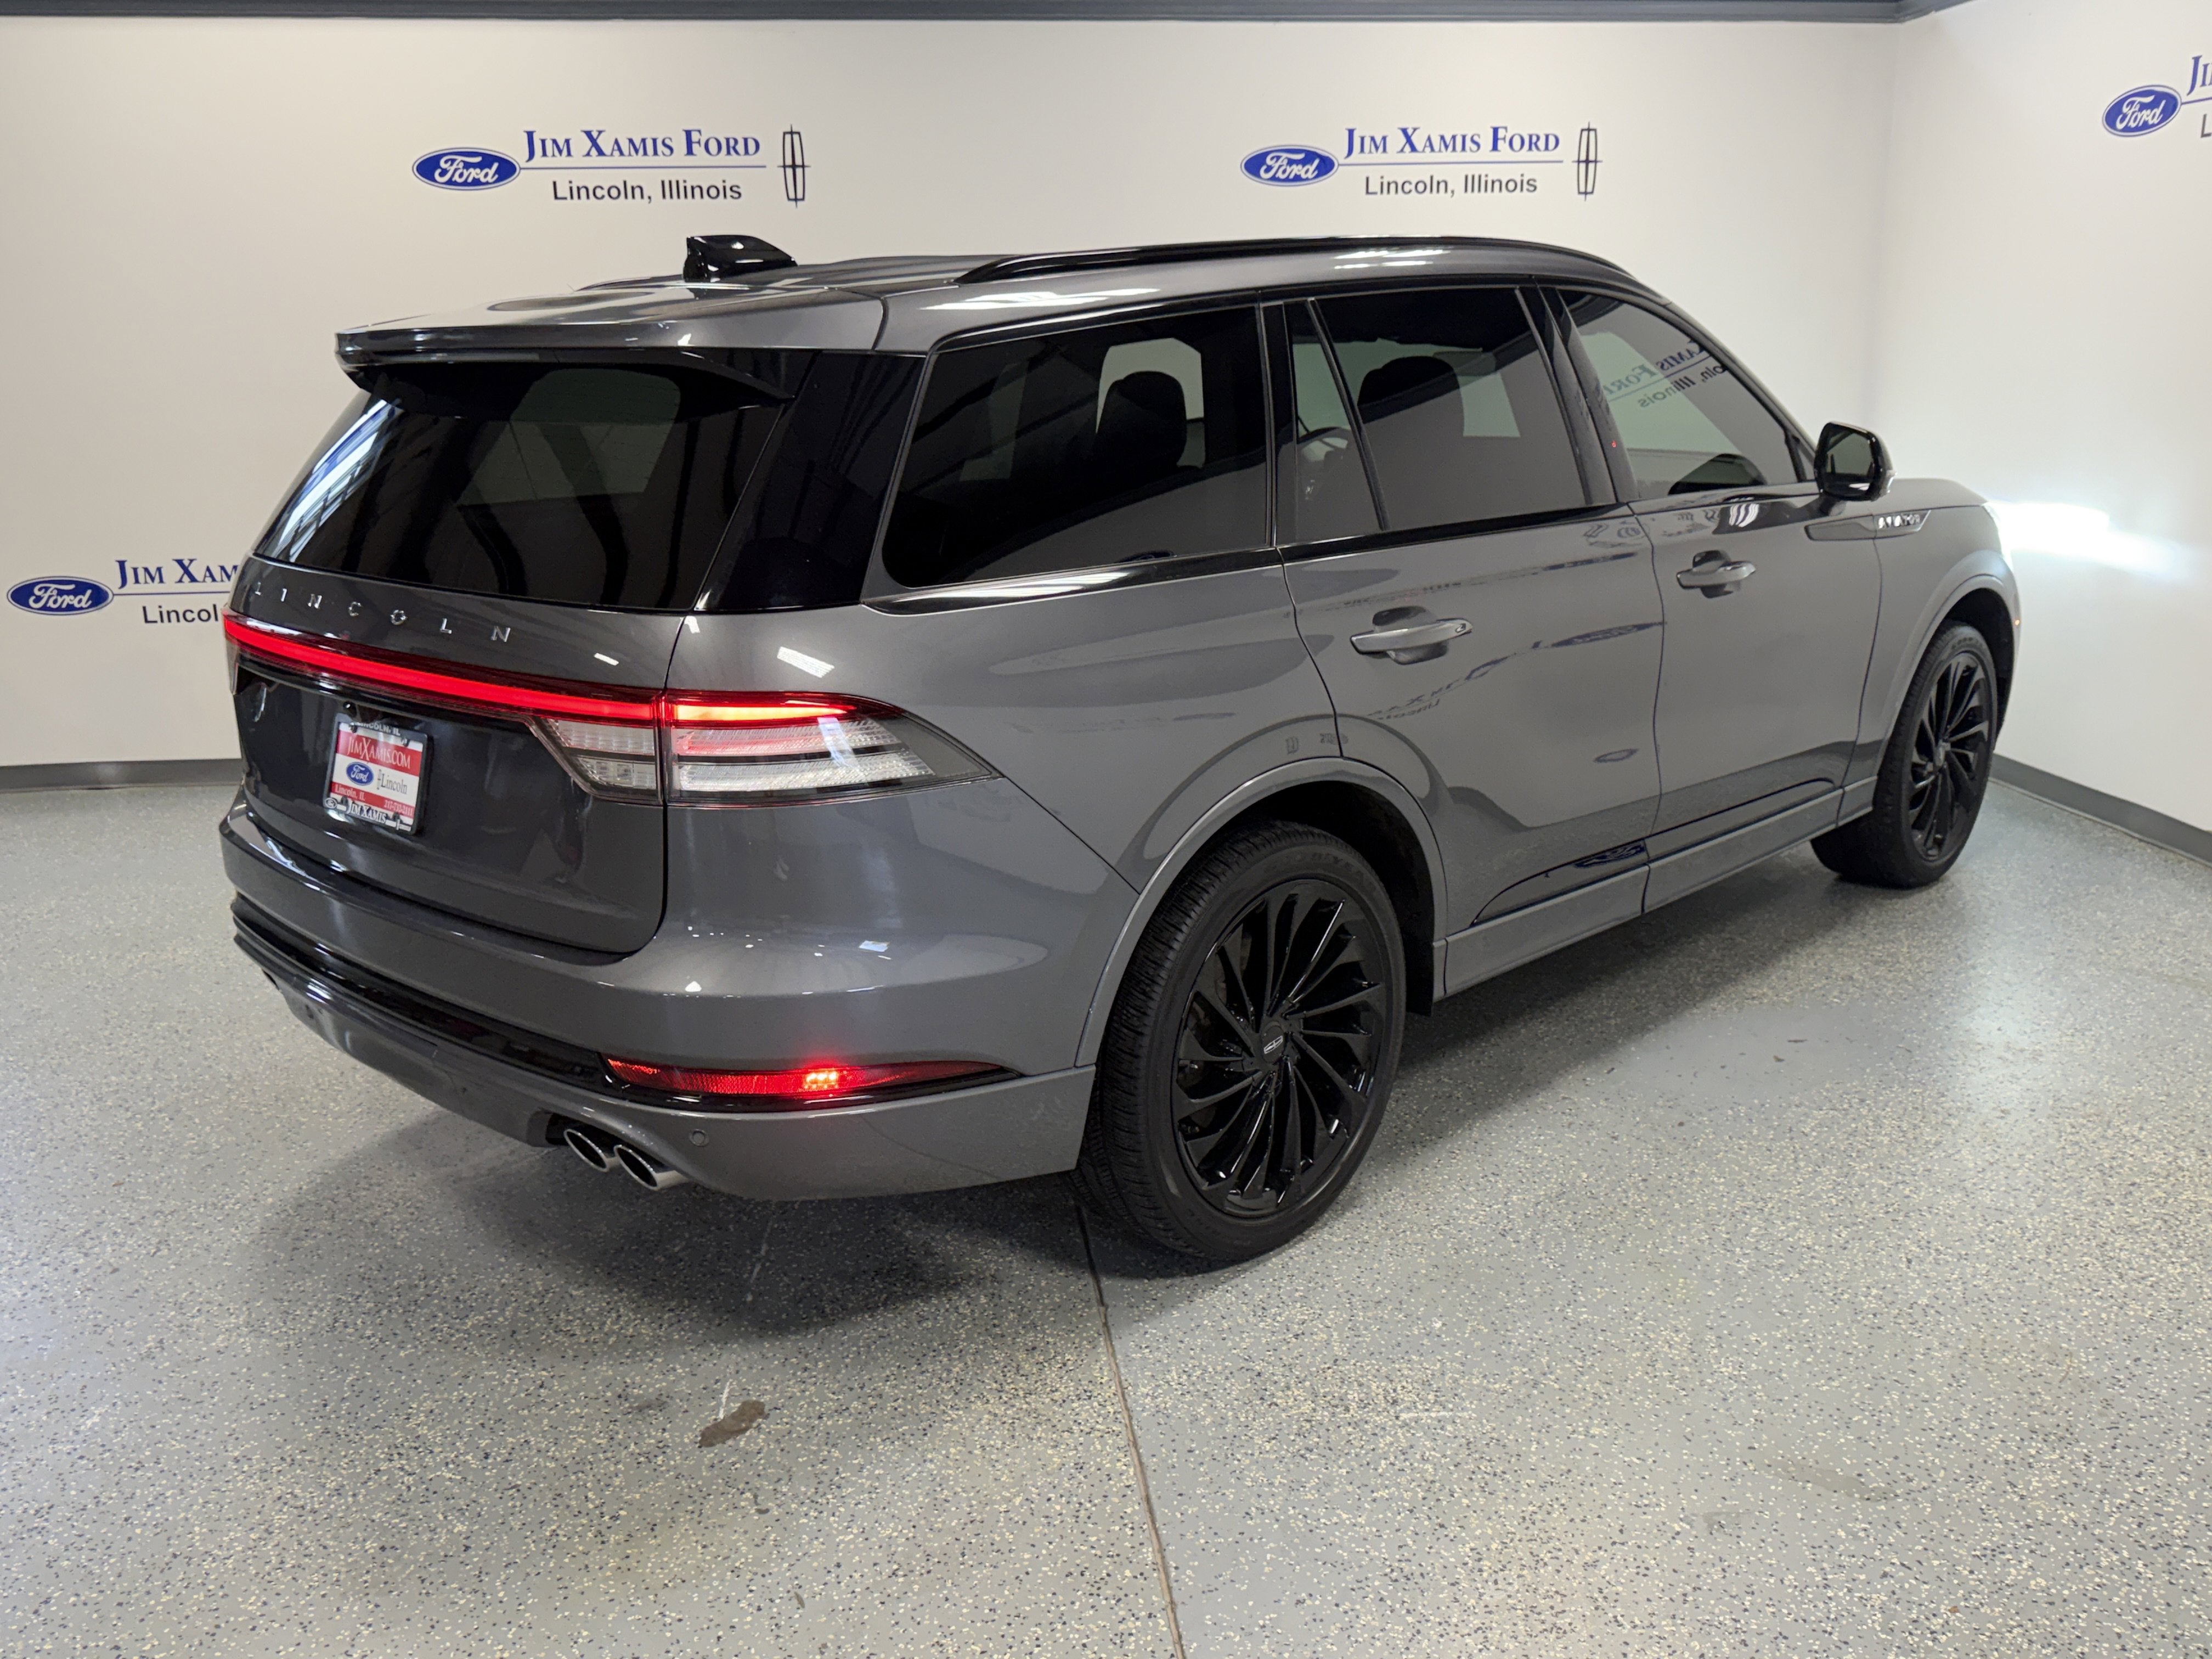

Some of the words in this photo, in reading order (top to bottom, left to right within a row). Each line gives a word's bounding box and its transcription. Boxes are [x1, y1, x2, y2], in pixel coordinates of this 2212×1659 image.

[2187, 55, 2212, 96] JI
[2116, 94, 2166, 130] Ford
[523, 130, 573, 163] JIM
[580, 129, 674, 157] XAMIS
[682, 129, 760, 157] FORD
[1344, 127, 1388, 160] JIM
[1396, 127, 1481, 154] XAMIS
[1489, 126, 1560, 153] FORD
[434, 154, 498, 184] Ford
[1259, 151, 1320, 180] Ford
[552, 179, 652, 204] Lincoln,
[661, 179, 742, 200] Illinois
[1365, 174, 1455, 198] Lincoln,
[1464, 173, 1538, 194] Illinois
[115, 560, 166, 590] JIM
[172, 558, 239, 583] XAM
[28, 583, 92, 608] Ford
[142, 604, 218, 624] Lincol
[254, 582, 511, 642] LINCOLN
[350, 764, 369, 783] Ford
[381, 773, 408, 795] Lincoln
[346, 802, 360, 816] JIM
[360, 805, 387, 823] XAMIS
